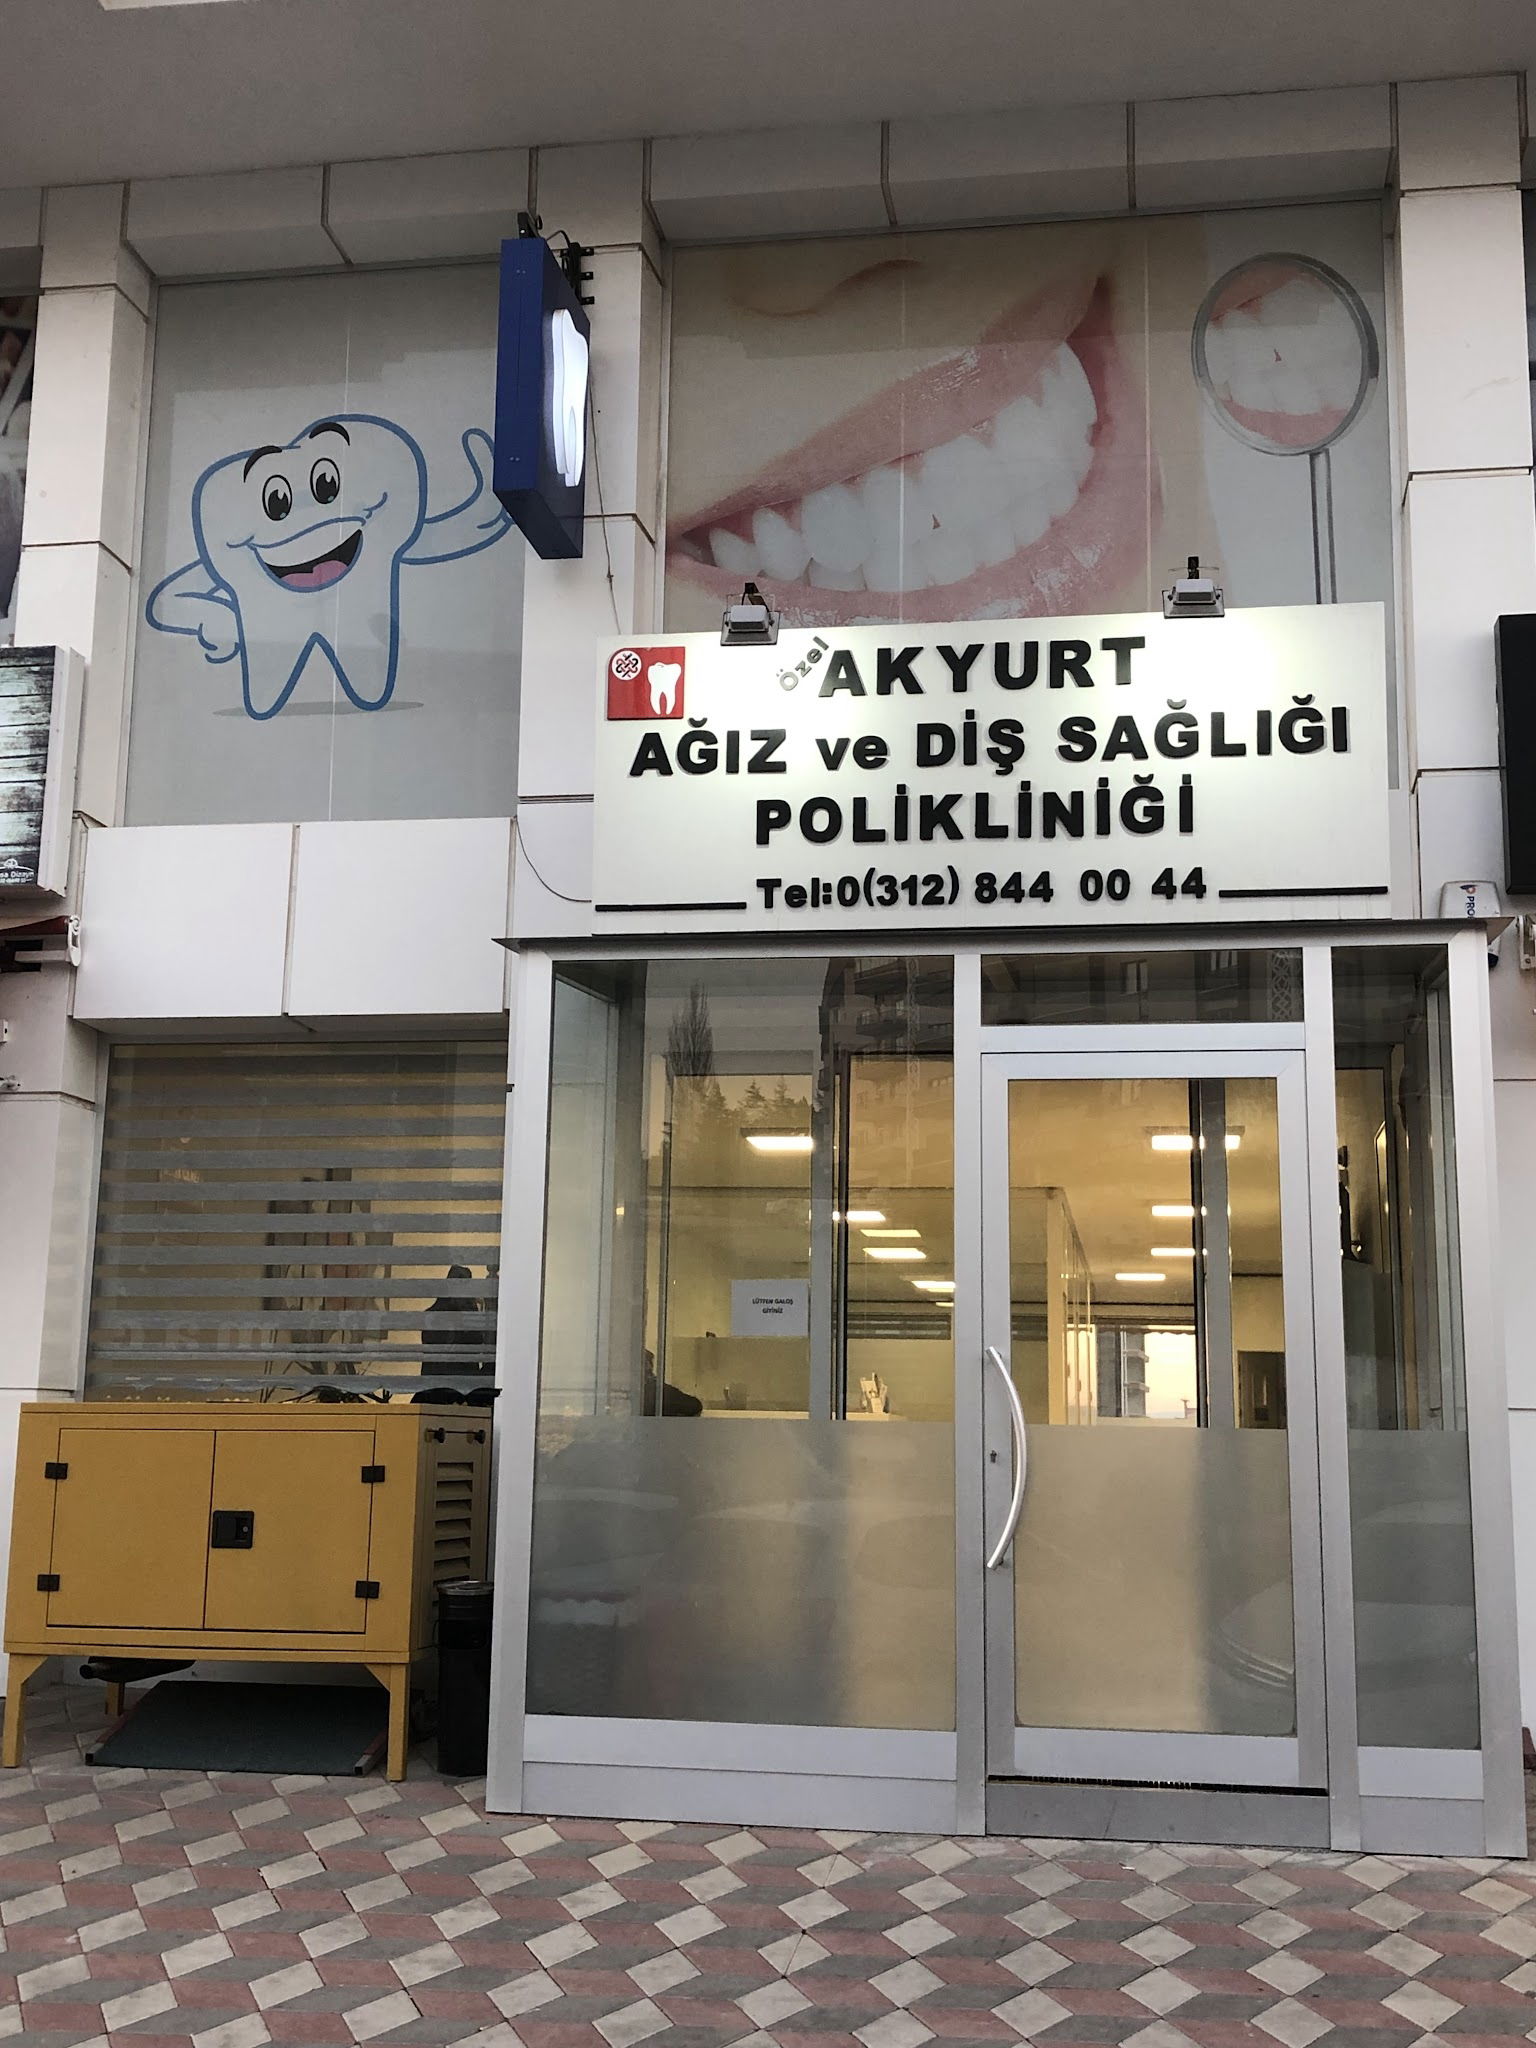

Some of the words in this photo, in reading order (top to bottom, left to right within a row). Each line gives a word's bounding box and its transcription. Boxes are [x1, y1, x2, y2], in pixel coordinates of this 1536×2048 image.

[776, 636, 830, 692] Özel
[818, 636, 1146, 698] AKYURT
[629, 717, 787, 778] AĞIZ
[815, 735, 889, 771] ve
[916, 709, 1026, 777] DİŞ
[1057, 694, 1348, 763] SAĞLIĞI
[755, 774, 1195, 846] POLİKLİNİĞİ
[974, 870, 1054, 905] 844
[1079, 868, 1131, 902] 00
[1151, 866, 1207, 900] 44
[1466, 896, 1475, 918] PRO
